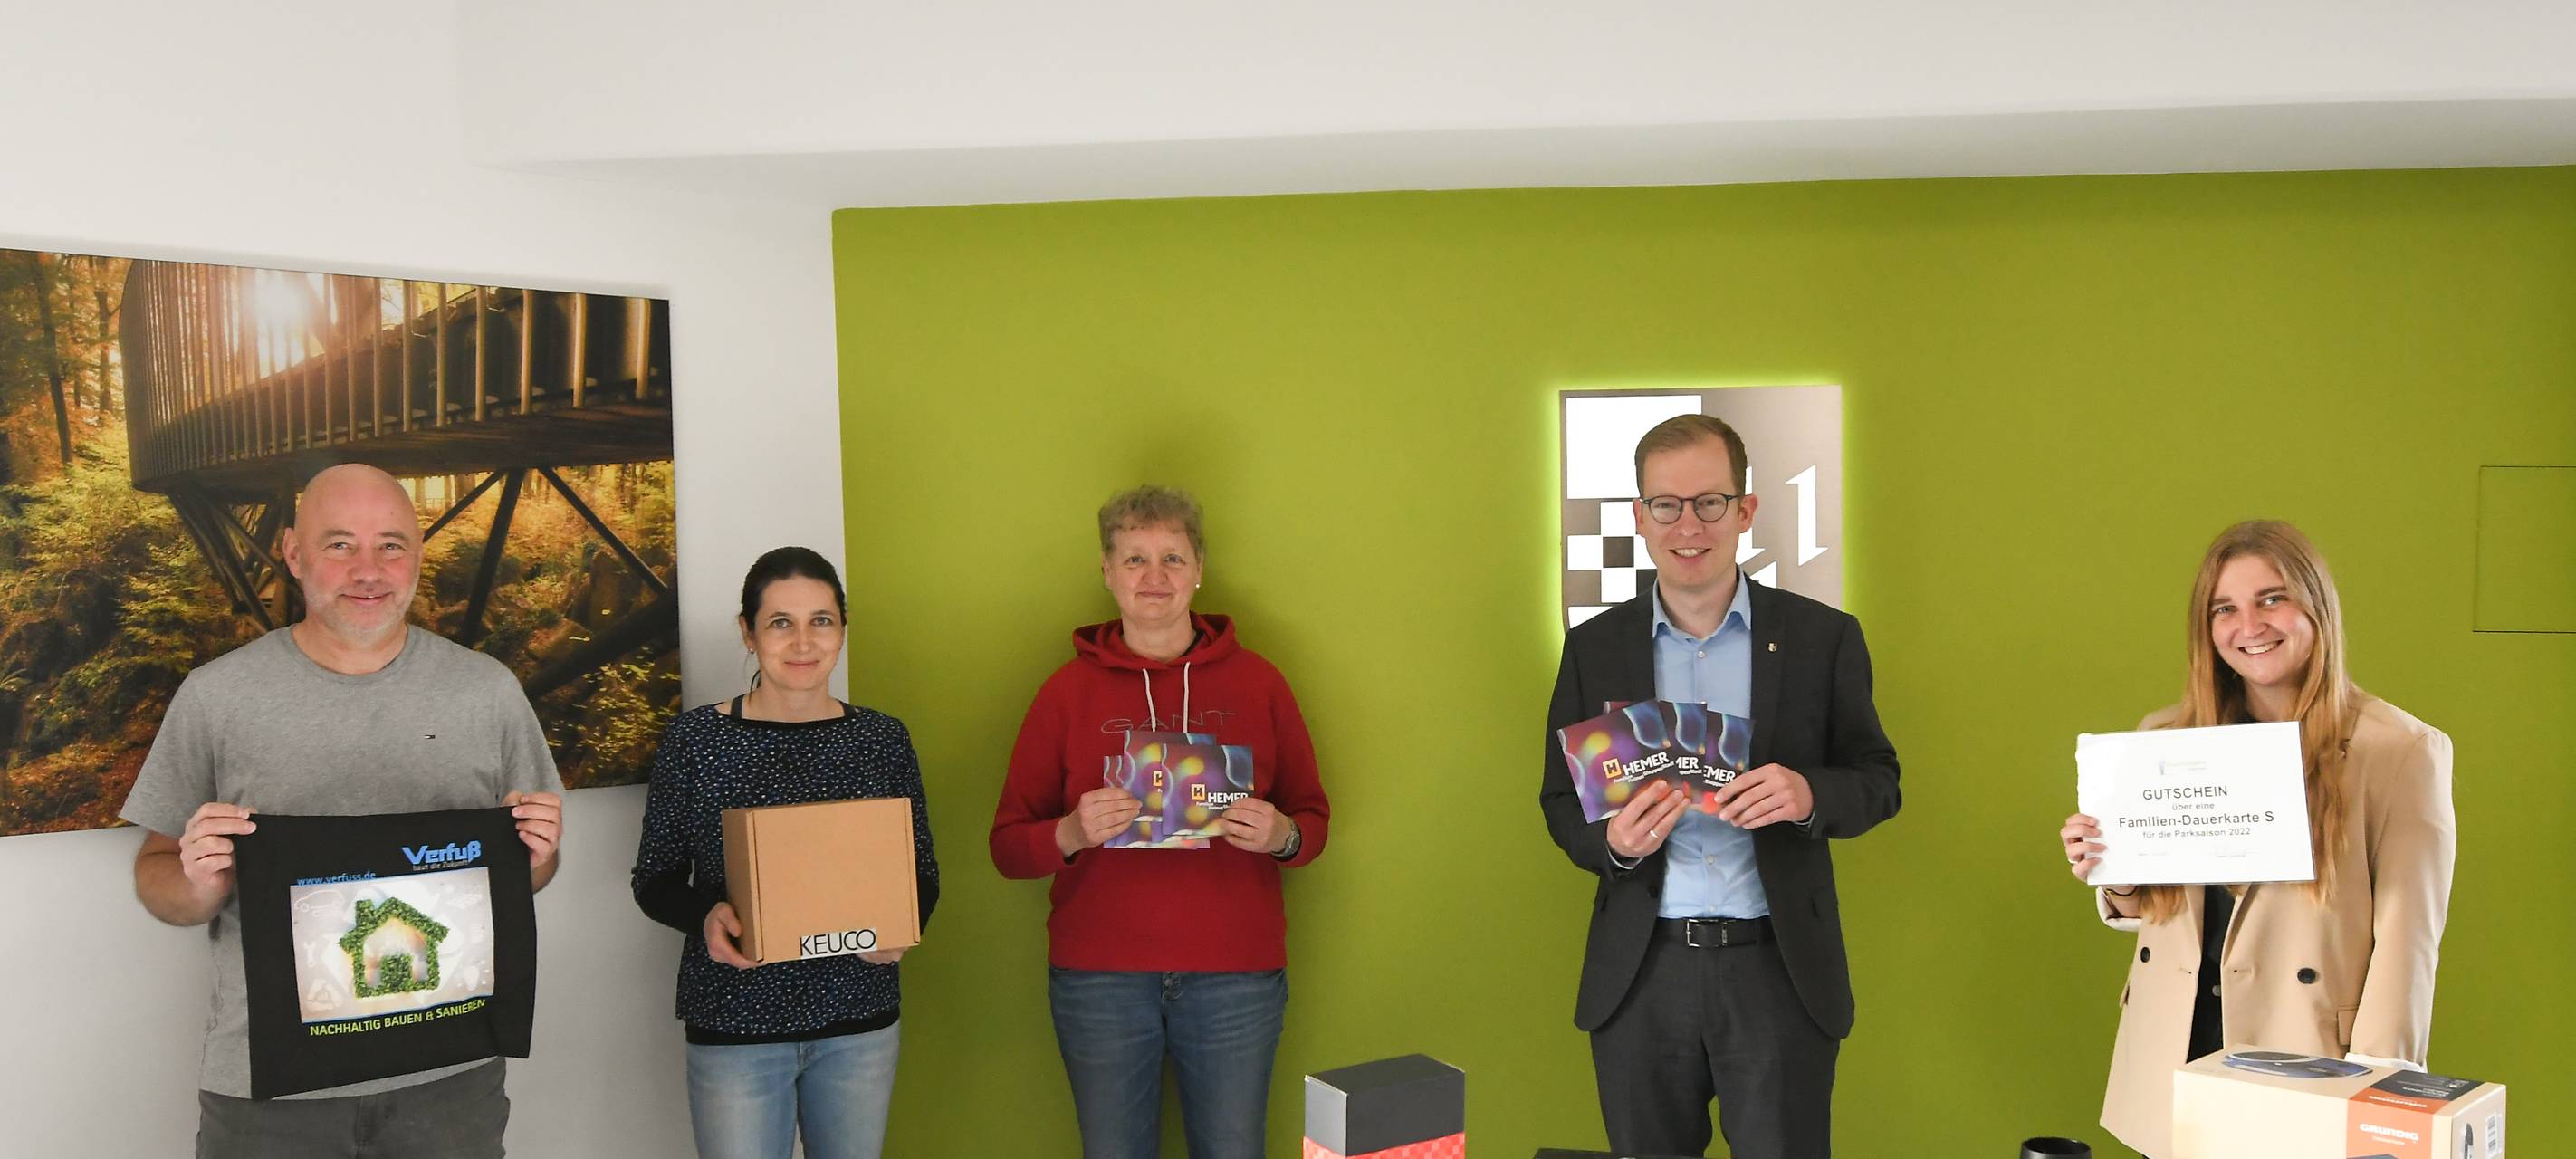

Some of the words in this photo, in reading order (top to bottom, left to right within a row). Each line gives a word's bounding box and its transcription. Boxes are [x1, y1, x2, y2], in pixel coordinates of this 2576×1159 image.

[1101, 710, 1236, 733] GANT
[1623, 752, 1670, 776] HEMER
[2142, 785, 2228, 800] GUTSCHEIN
[2172, 802, 2193, 811] über
[2195, 802, 2216, 810] eine
[2119, 813, 2259, 829] Familien-Dauerkarte
[2265, 811, 2274, 822] S
[2142, 831, 2155, 839] für
[2158, 830, 2172, 838] die
[2174, 829, 2226, 838] Parksaison
[2228, 828, 2251, 836] 2022
[401, 840, 482, 864] Verfuß
[296, 871, 377, 886] www.verfuss.de
[800, 928, 876, 956] KEUCO
[310, 1019, 381, 1036] NACHHALTIG
[384, 1012, 422, 1028] BAUEN
[426, 1011, 434, 1021] &
[436, 999, 486, 1019] SANIEREN
[2360, 1123, 2419, 1141] GRUNDIG
